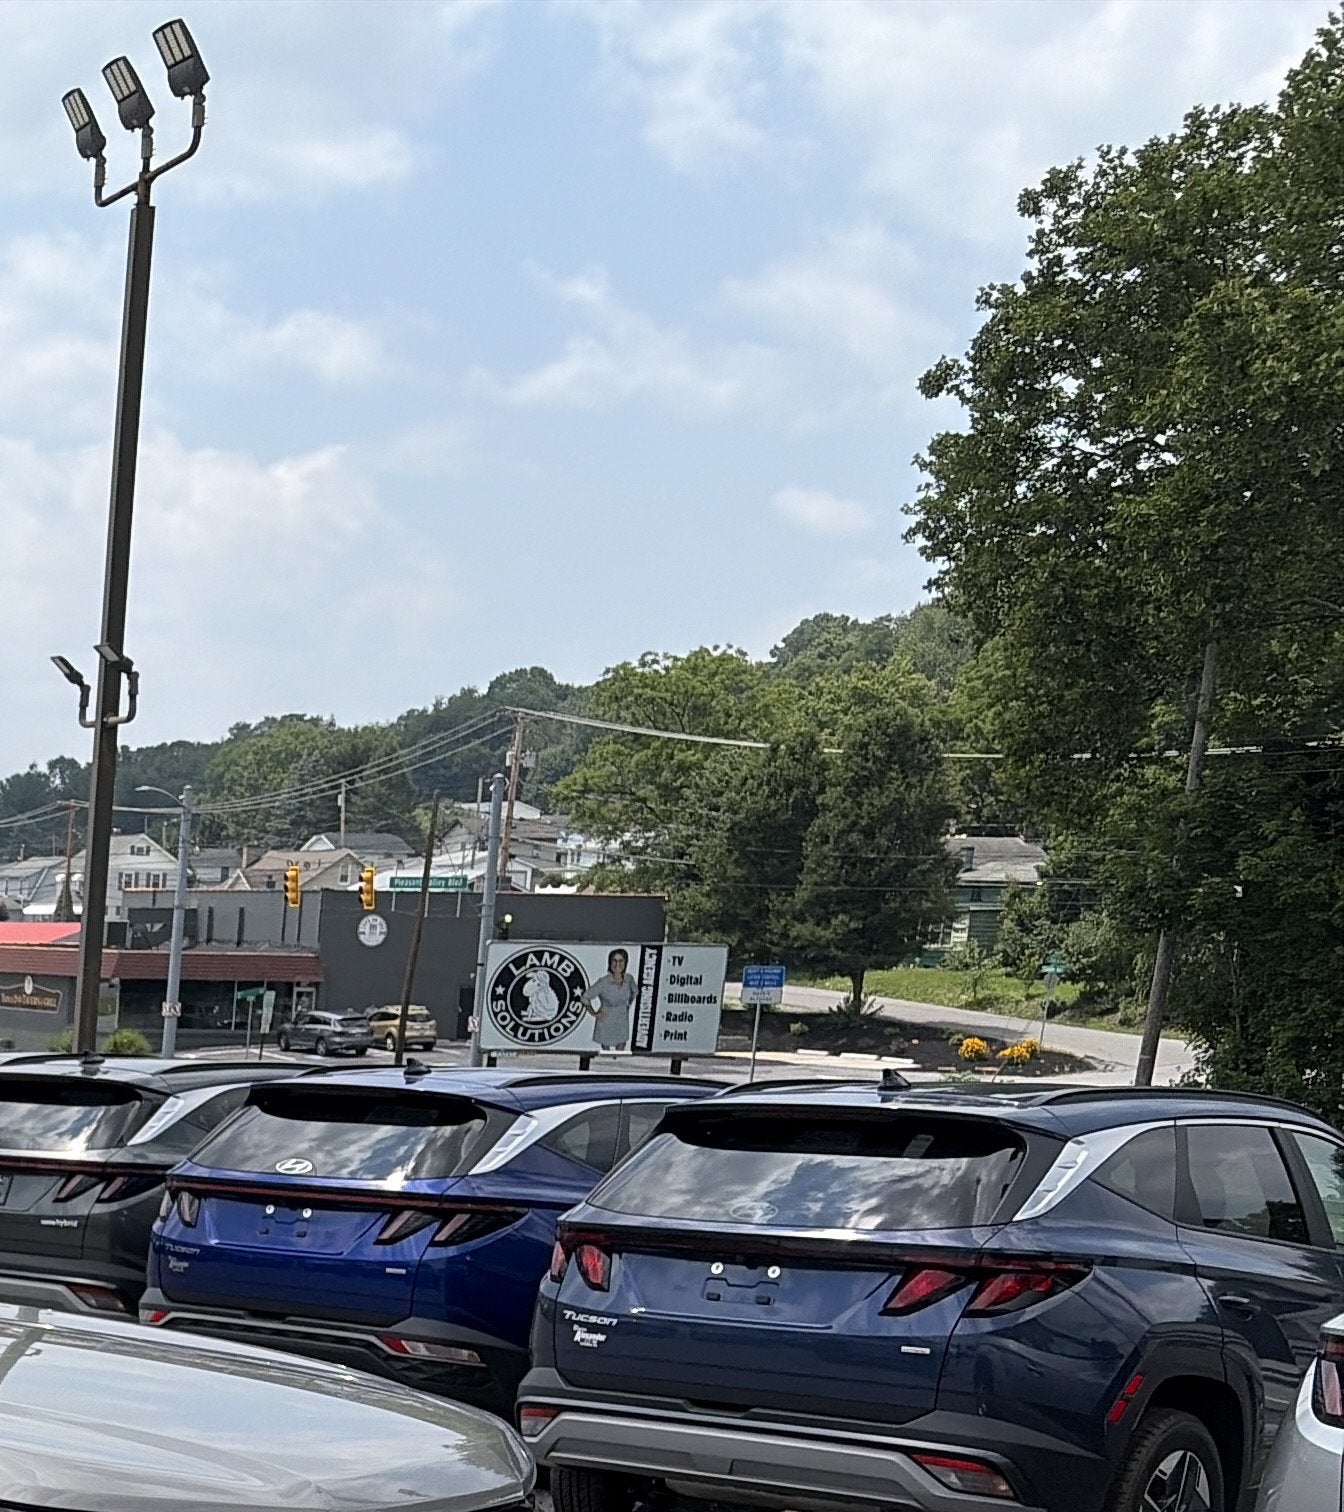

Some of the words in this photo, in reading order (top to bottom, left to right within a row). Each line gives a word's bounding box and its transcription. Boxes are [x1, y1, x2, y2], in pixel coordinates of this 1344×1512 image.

[509, 951, 576, 978] LAMB
[671, 955, 684, 967] TV
[669, 974, 703, 987] Digital
[667, 993, 718, 1005] Billboards
[492, 999, 583, 1042] SOLUTIONS
[665, 1011, 694, 1023] Radio
[663, 1029, 688, 1042] Print
